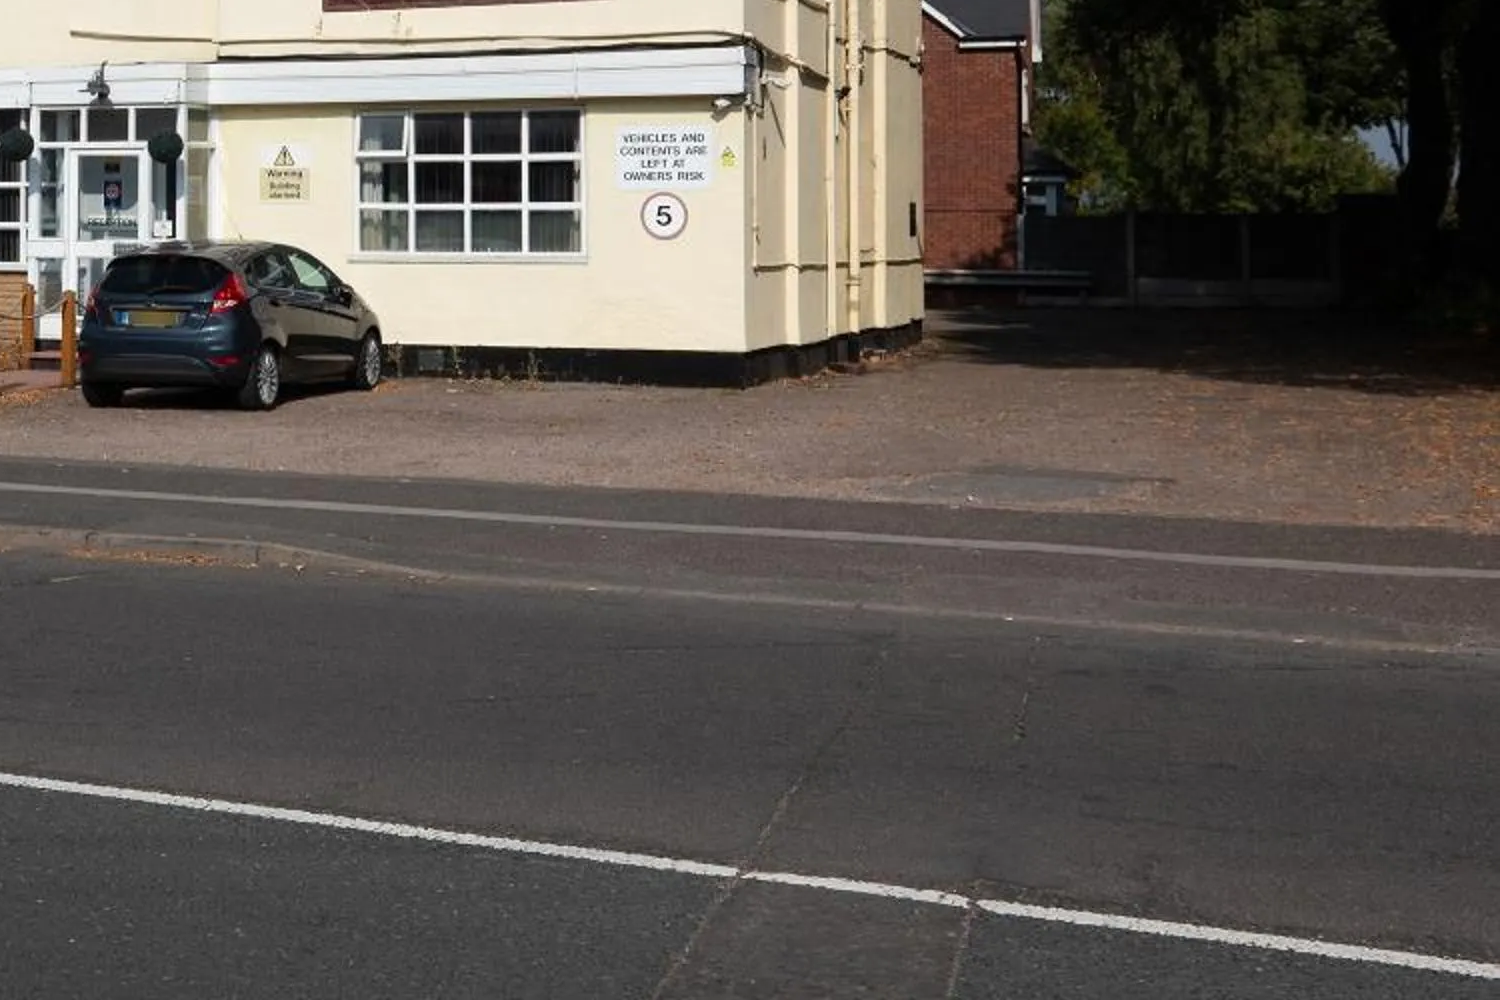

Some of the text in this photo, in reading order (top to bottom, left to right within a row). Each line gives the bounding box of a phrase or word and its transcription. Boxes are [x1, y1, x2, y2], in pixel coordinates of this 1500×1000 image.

[622, 133, 705, 143] VEHICLES AND
[619, 146, 709, 156] CONTENTS ARE
[641, 159, 686, 168] LEFT AT
[623, 171, 705, 181] OWNERS RISK
[655, 205, 673, 226] 5
